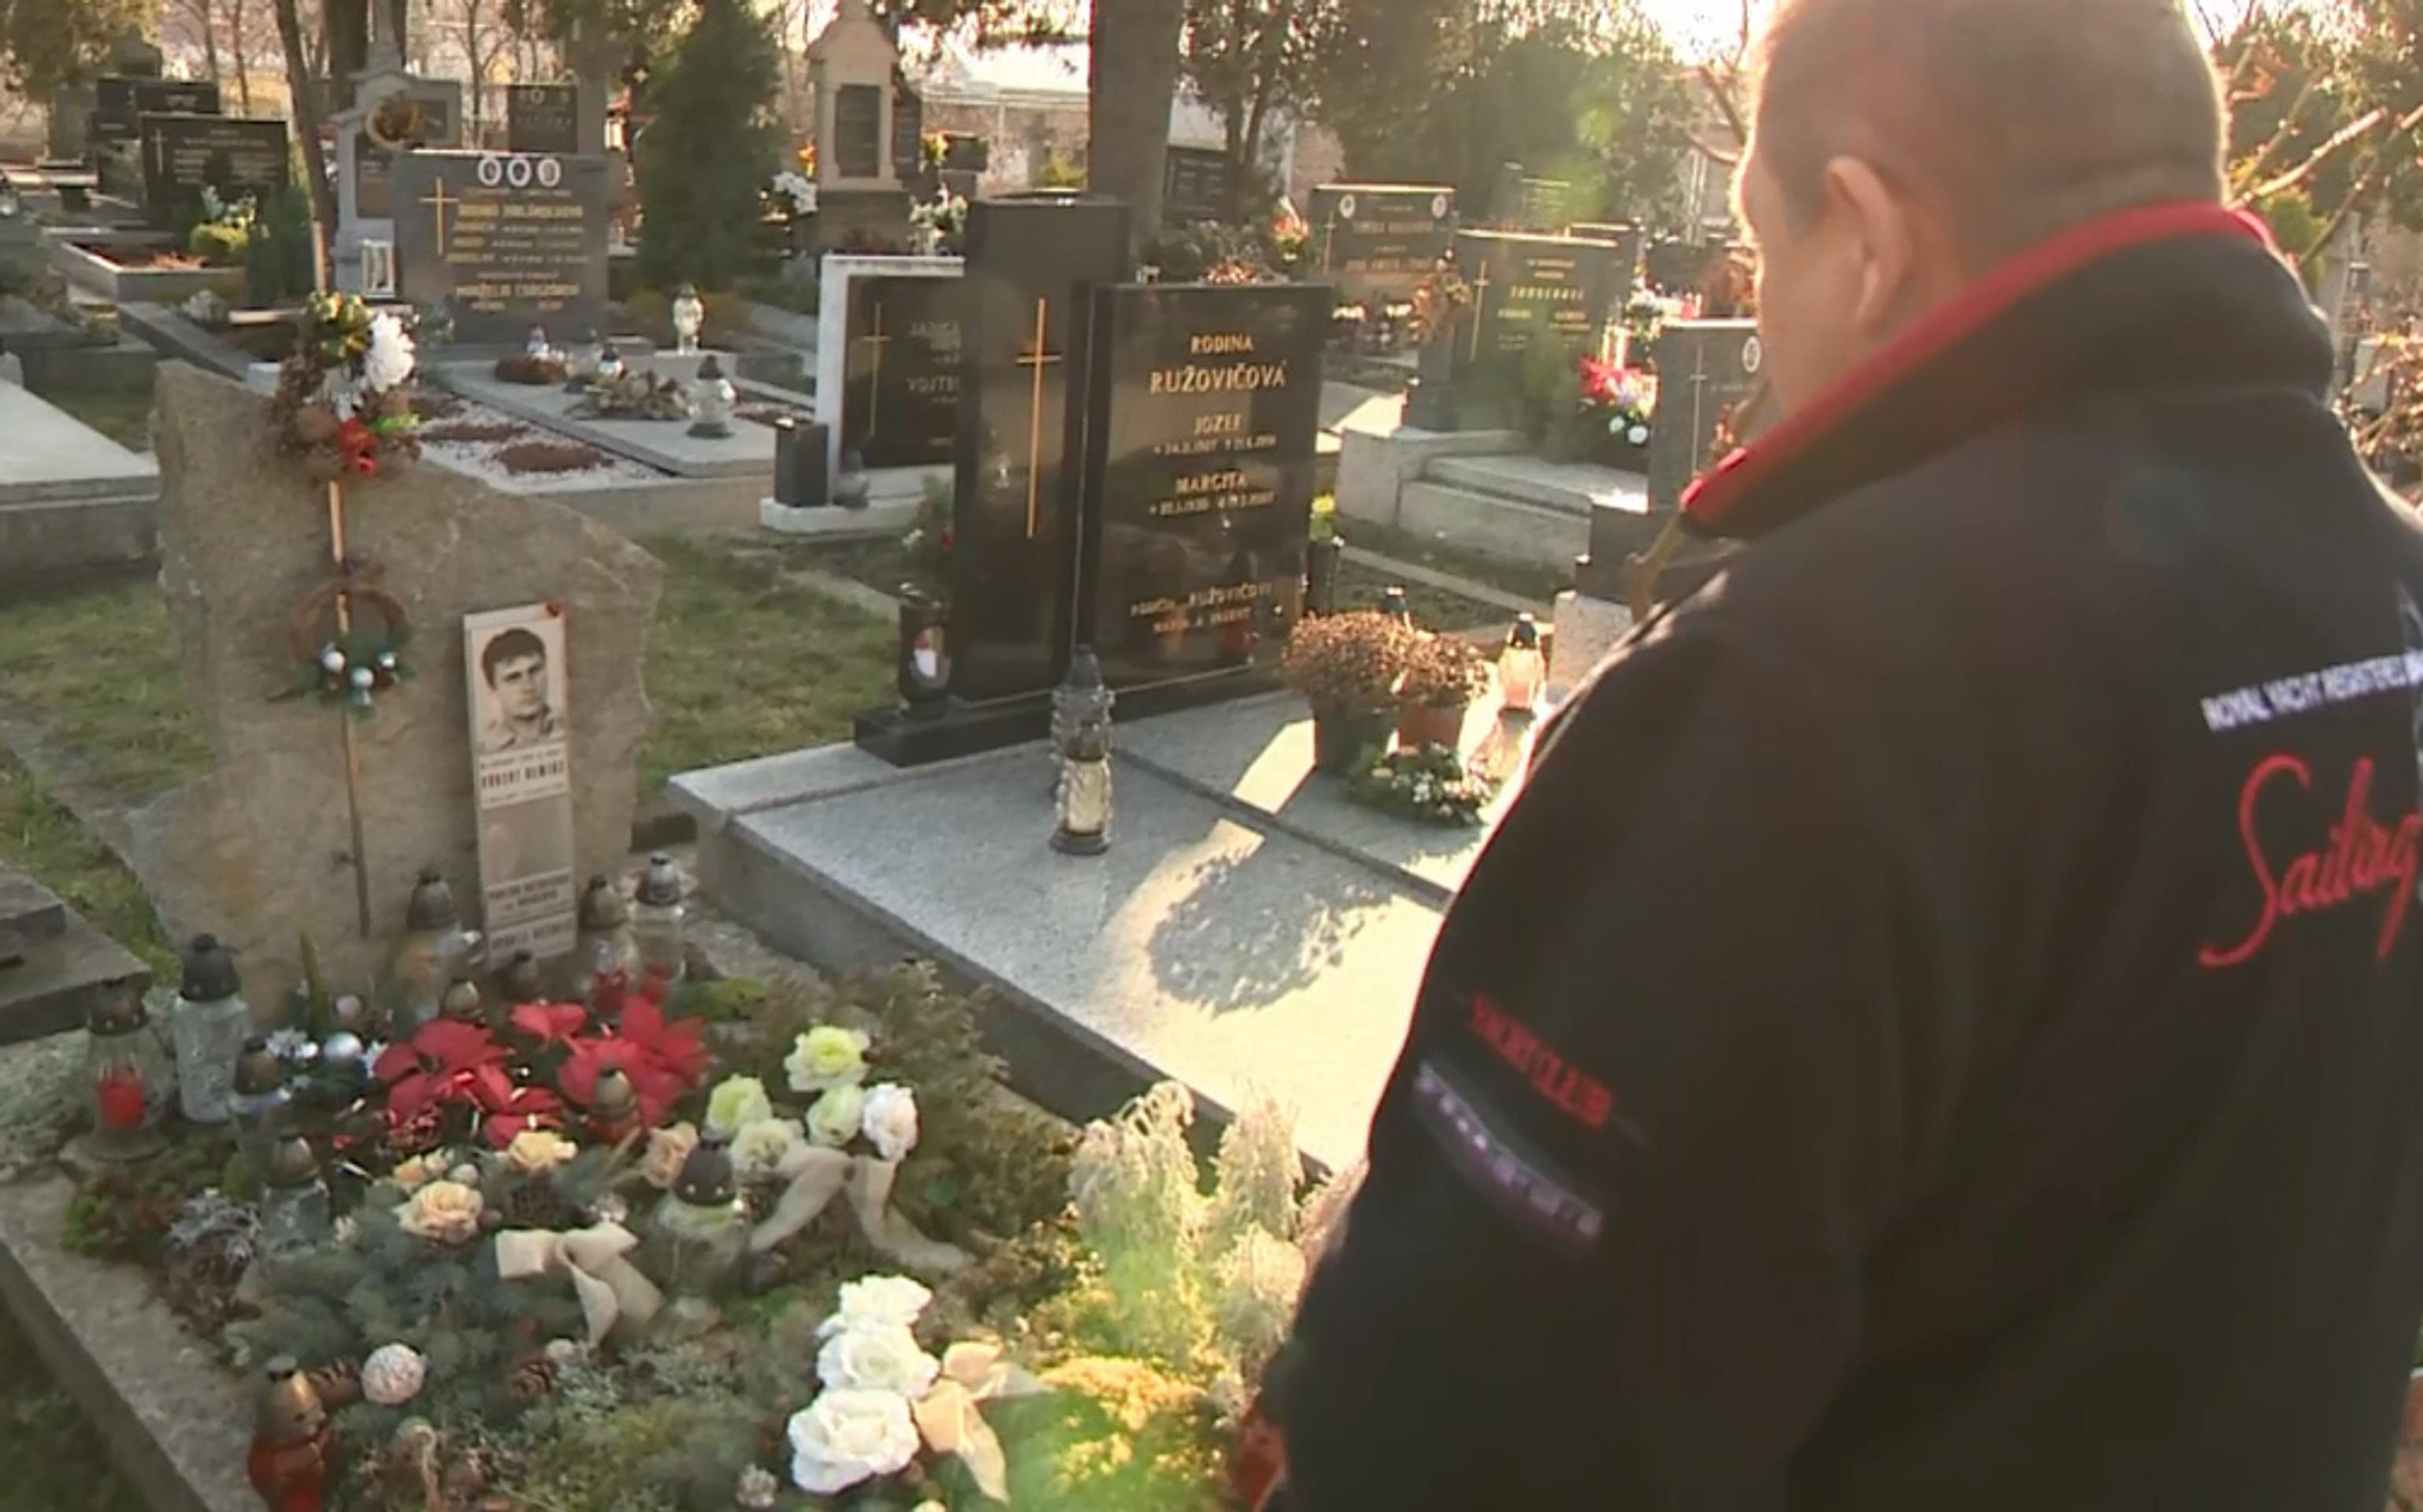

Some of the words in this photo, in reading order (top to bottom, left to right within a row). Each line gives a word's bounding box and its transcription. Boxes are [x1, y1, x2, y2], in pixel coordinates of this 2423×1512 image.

[1190, 335, 1254, 354] RODINA
[1149, 359, 1287, 394] RUŽOVIČOVÁ
[1193, 413, 1241, 434] JOZEF
